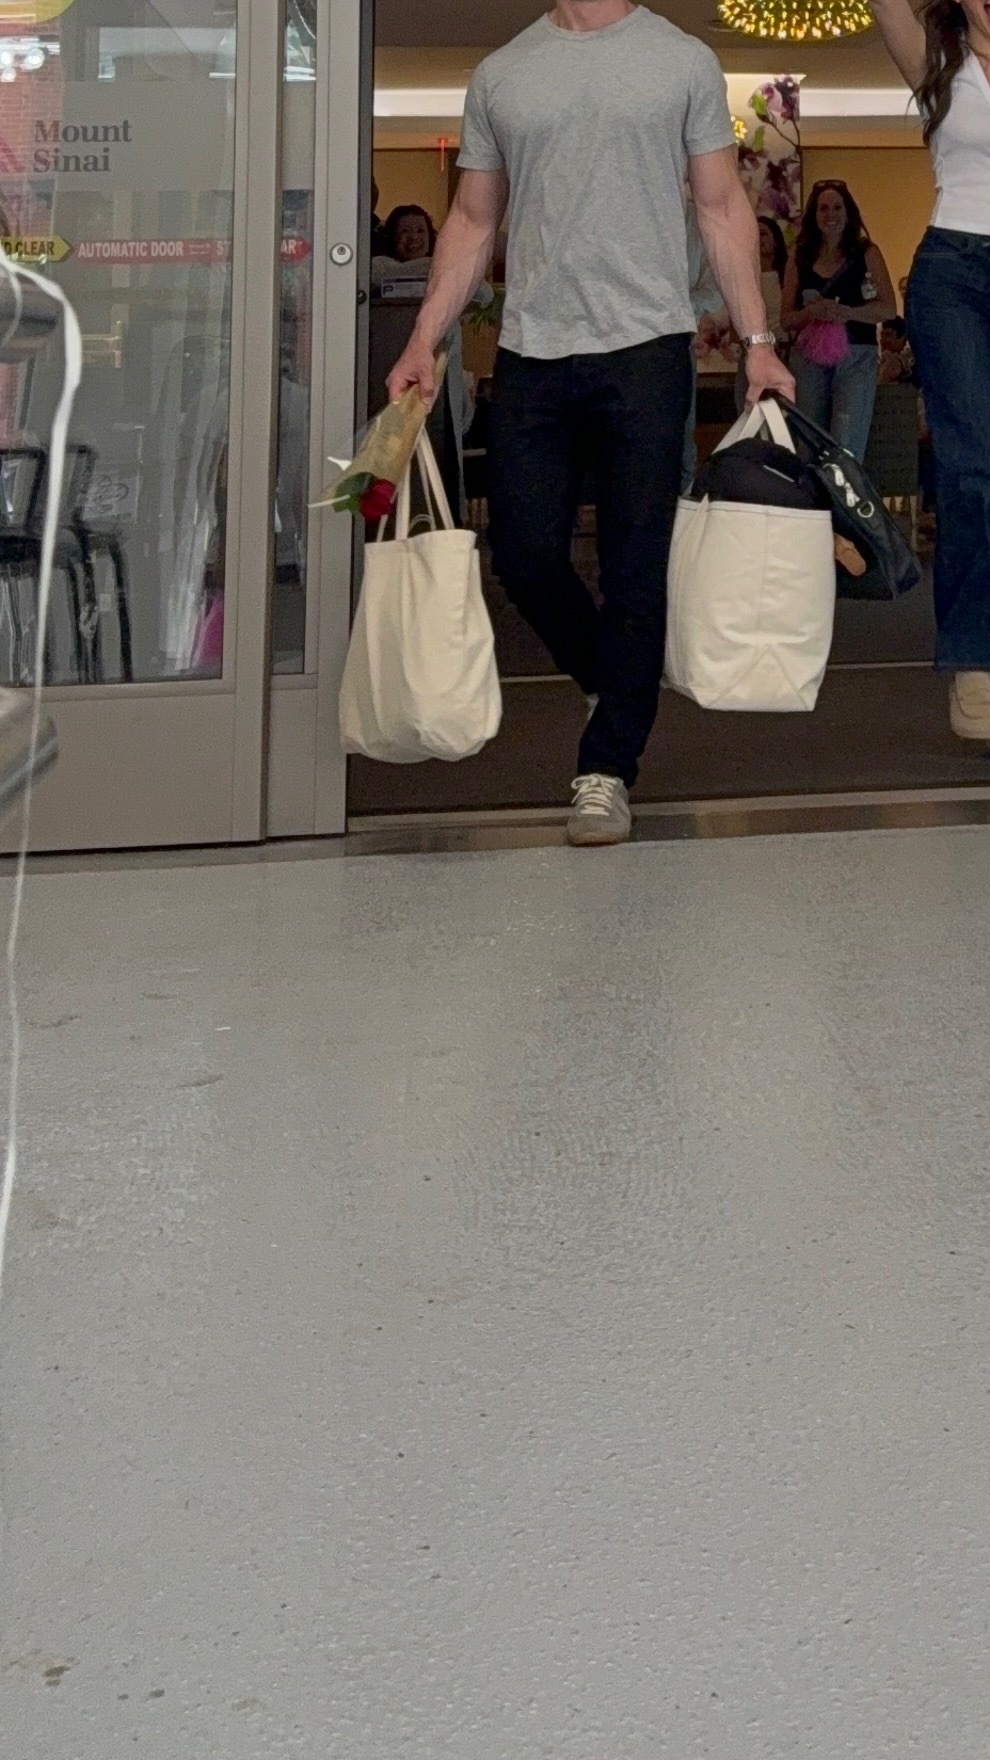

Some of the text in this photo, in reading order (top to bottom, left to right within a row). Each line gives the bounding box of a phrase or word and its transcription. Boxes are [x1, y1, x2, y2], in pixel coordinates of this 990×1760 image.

[34, 120, 133, 143] Mount
[33, 147, 112, 173] Sinai
[78, 242, 148, 258] AUTOMATIC
[151, 241, 185, 257] DOOR
